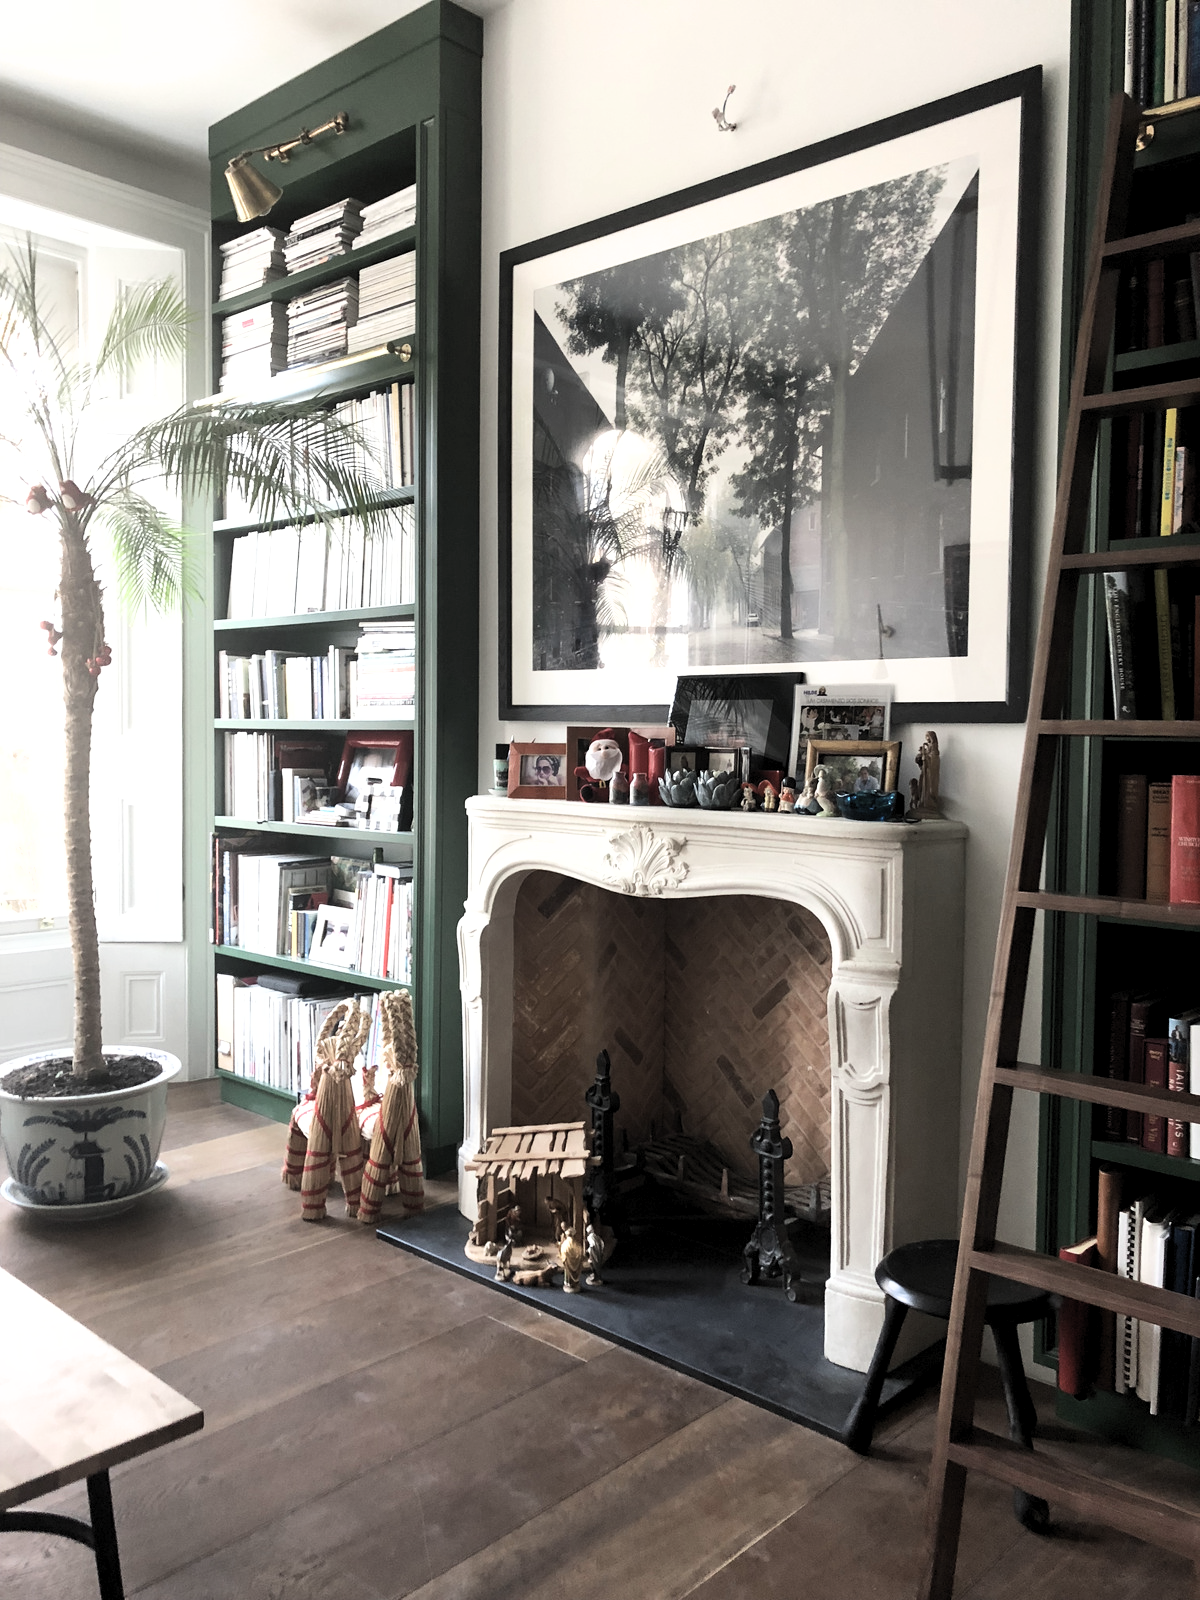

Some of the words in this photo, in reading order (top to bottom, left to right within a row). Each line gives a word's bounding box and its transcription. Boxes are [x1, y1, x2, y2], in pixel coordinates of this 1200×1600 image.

[1113, 604, 1121, 634] ENGLISH
[1115, 635, 1124, 666] COUNTRY
[1118, 668, 1126, 690] HOUSE
